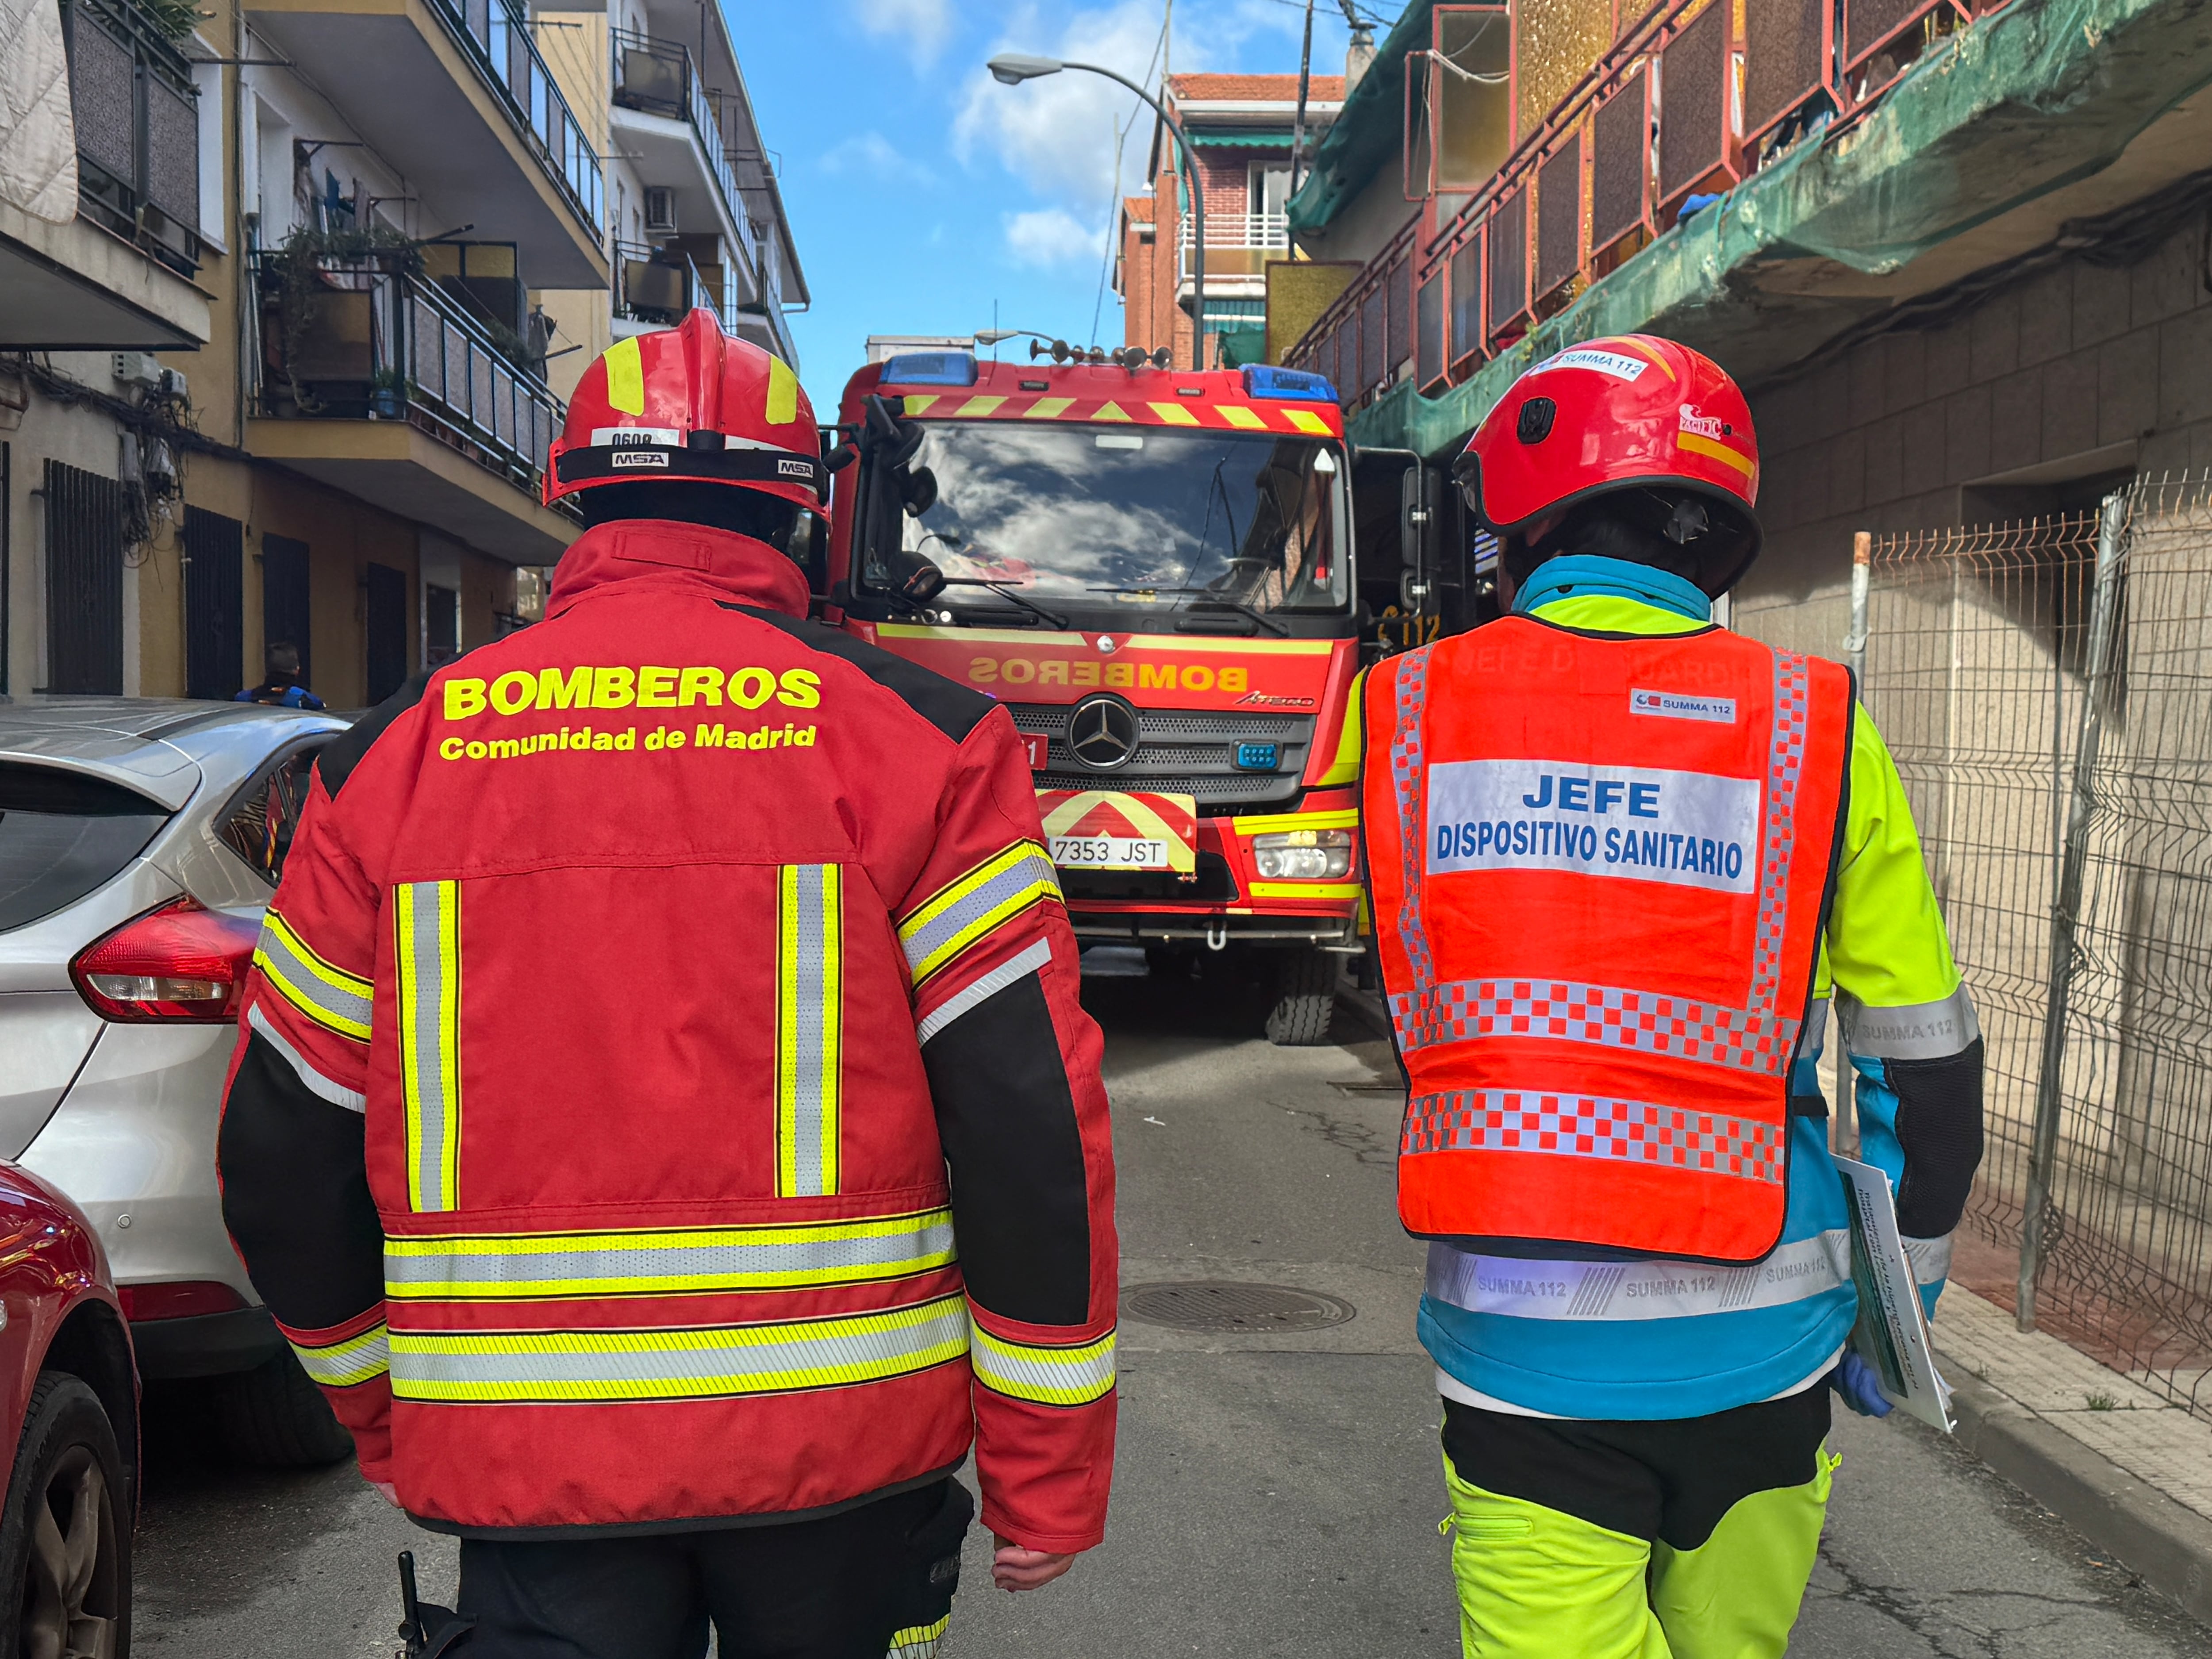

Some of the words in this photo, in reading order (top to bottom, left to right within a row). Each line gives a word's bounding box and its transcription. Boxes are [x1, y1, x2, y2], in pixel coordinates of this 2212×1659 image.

[1564, 353, 1613, 365] SUMMA
[1617, 361, 1643, 375] 112
[615, 454, 664, 465] MSA
[781, 462, 812, 476] MSA
[444, 666, 821, 721] BOMBEROS
[1663, 699, 1709, 712] SUMMA
[1712, 705, 1731, 714] 112
[439, 726, 635, 760] Comunidad
[644, 725, 685, 751] de
[694, 723, 817, 752] Madrid
[1522, 774, 1661, 818] JEFE
[1056, 841, 1109, 861] 7353
[1121, 842, 1161, 863] JST
[1437, 820, 1597, 861] DISPOSITIVO
[1604, 827, 1743, 879] SANITARIO
[1862, 1023, 1924, 1041] SUMMA
[1927, 1019, 1954, 1037] 112
[1765, 1262, 1810, 1283] SUMMA
[1478, 1277, 1536, 1297] SUMMA
[1538, 1281, 1567, 1297] 112
[1626, 1279, 1689, 1298] SUMMA
[1691, 1275, 1716, 1293] 112
